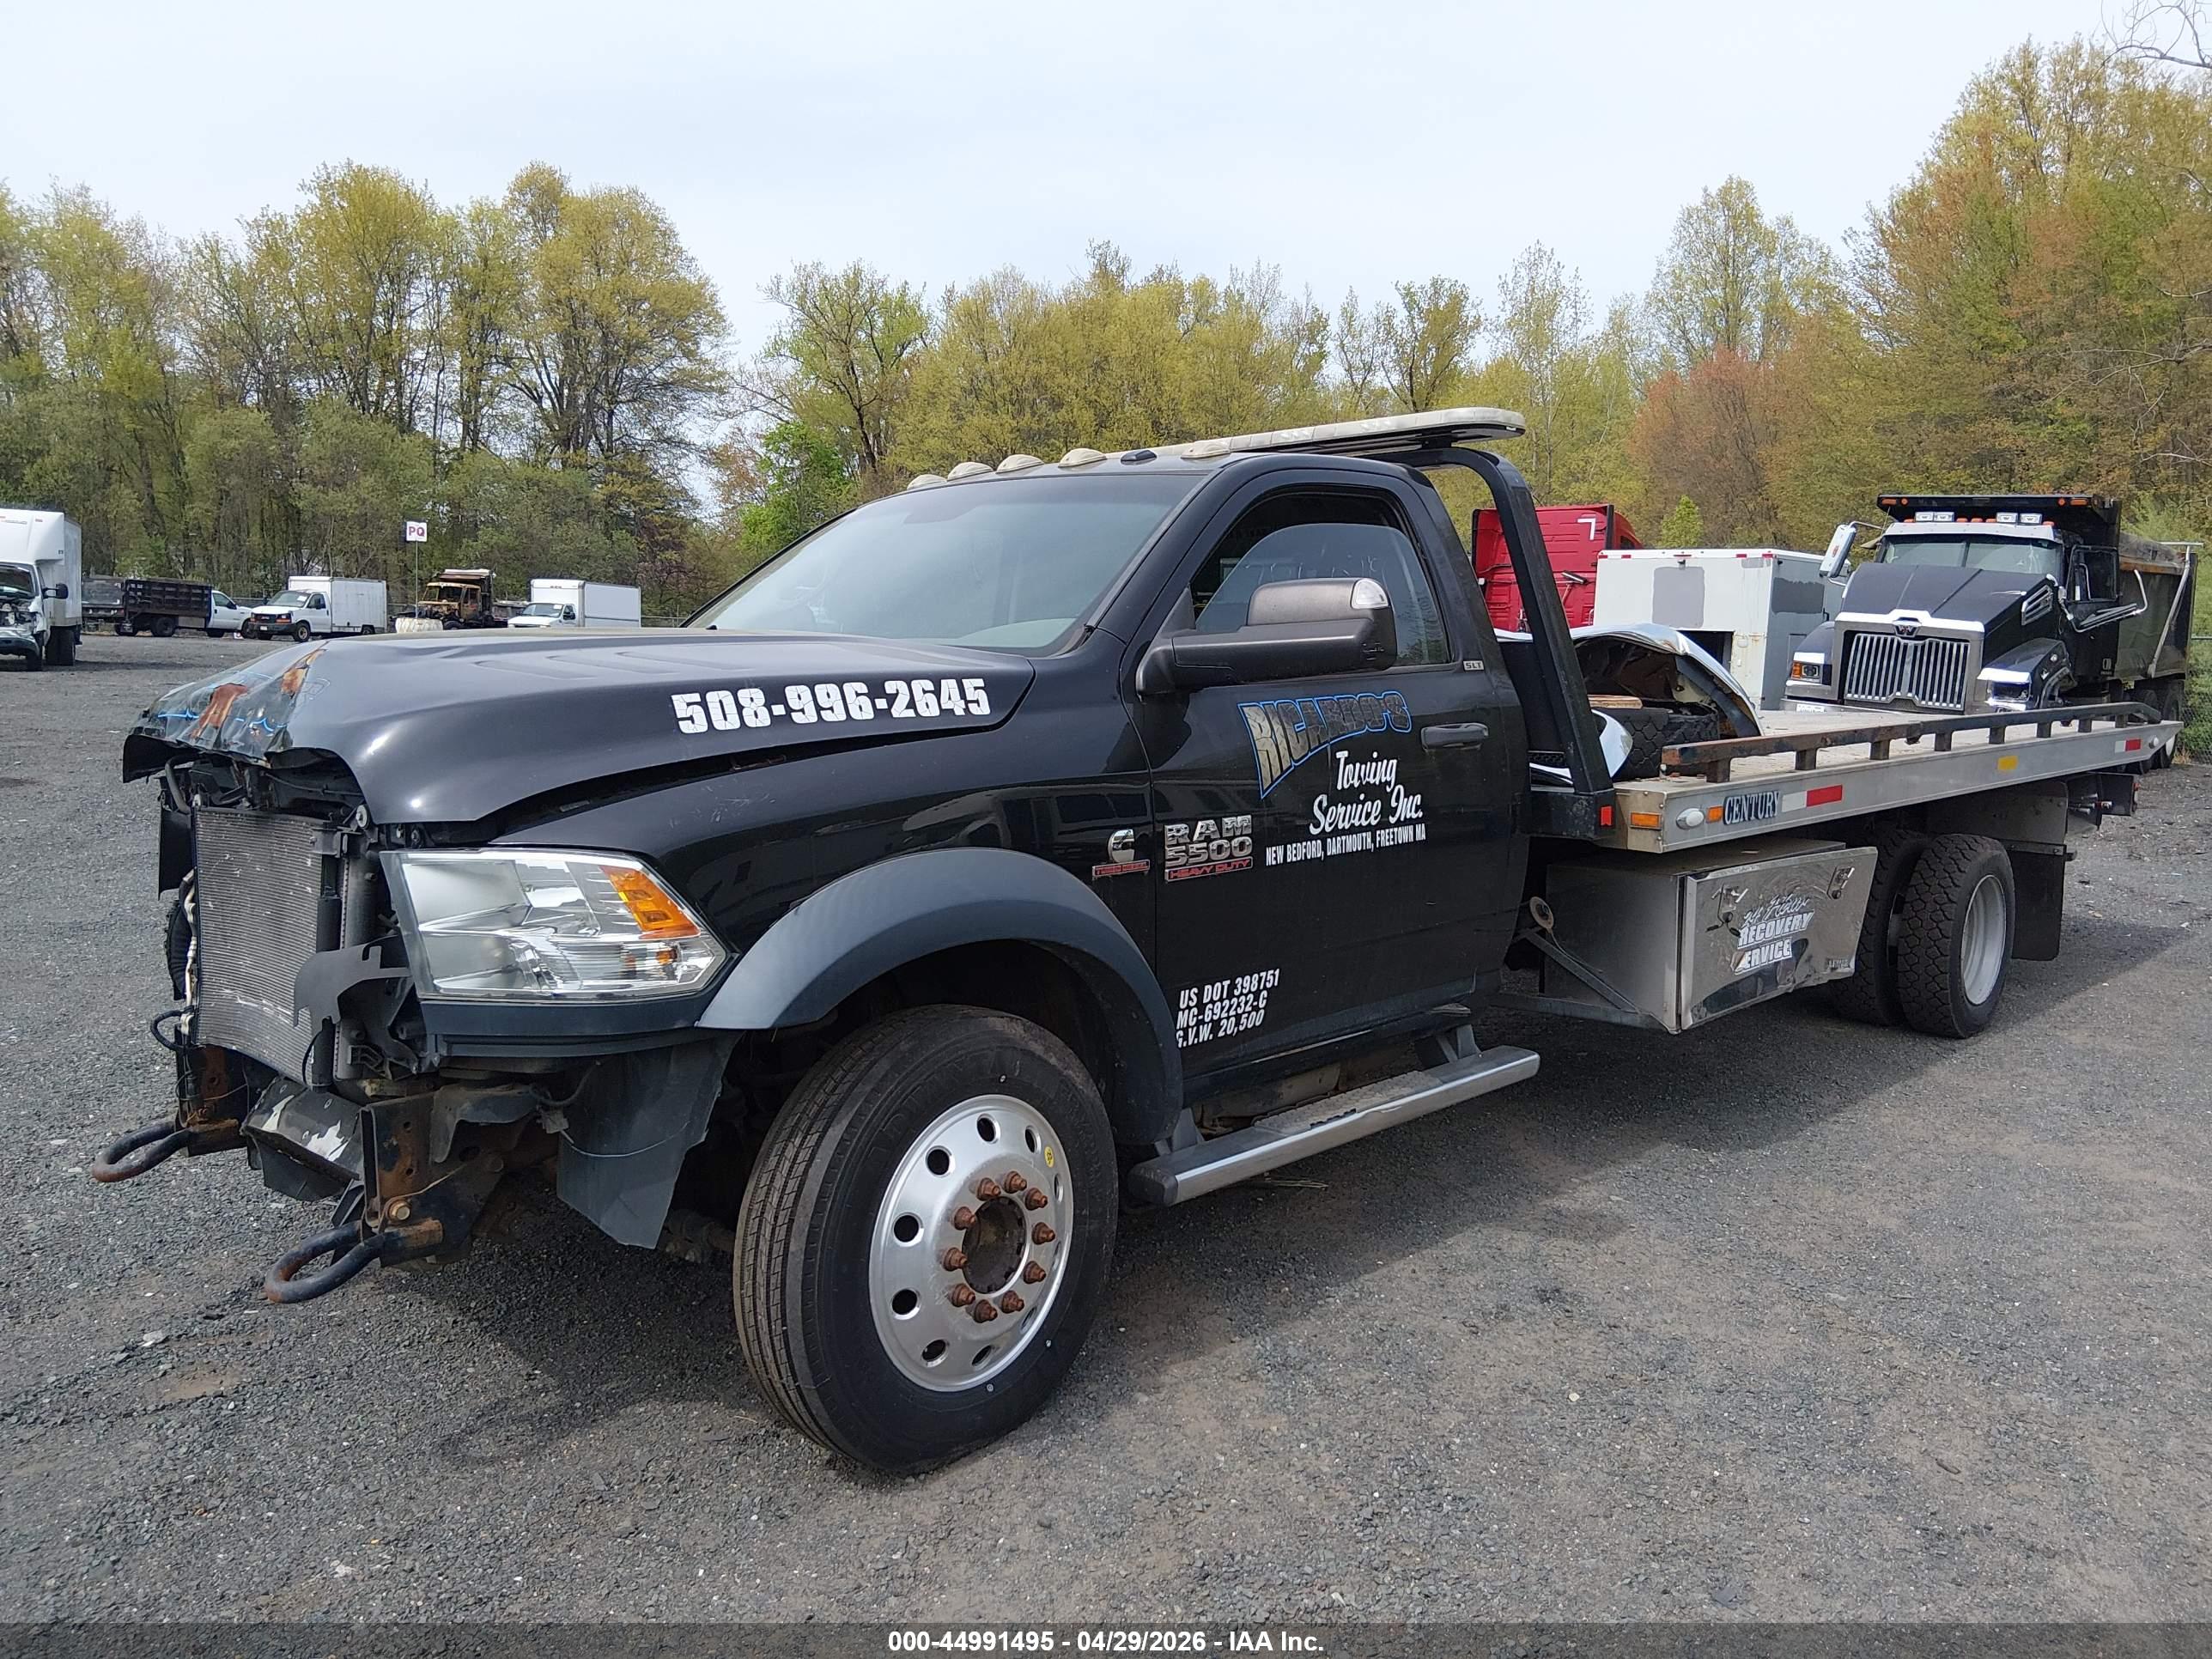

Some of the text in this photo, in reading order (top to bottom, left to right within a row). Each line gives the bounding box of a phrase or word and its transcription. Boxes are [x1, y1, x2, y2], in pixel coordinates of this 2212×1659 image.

[409, 526, 425, 537] PQ
[671, 678, 991, 734] 508-996-2645
[1336, 750, 1398, 792] Towing
[1310, 784, 1424, 836] Service Inc.
[1724, 791, 1780, 825] CENTURY
[1164, 815, 1252, 845] RAM
[1266, 823, 1426, 866] NEW BEDFORD, DARTMOUTH, FREETOWN MA
[1164, 836, 1253, 868] 5500
[1170, 859, 1250, 879] HEAVY DUTY
[1738, 912, 1814, 947] RECOVERY
[1738, 938, 1792, 972] ERVICE
[1179, 968, 1279, 1009] US DOT 398751
[1176, 990, 1268, 1030] MC-692232-C
[1218, 1009, 1265, 1037] 20,500
